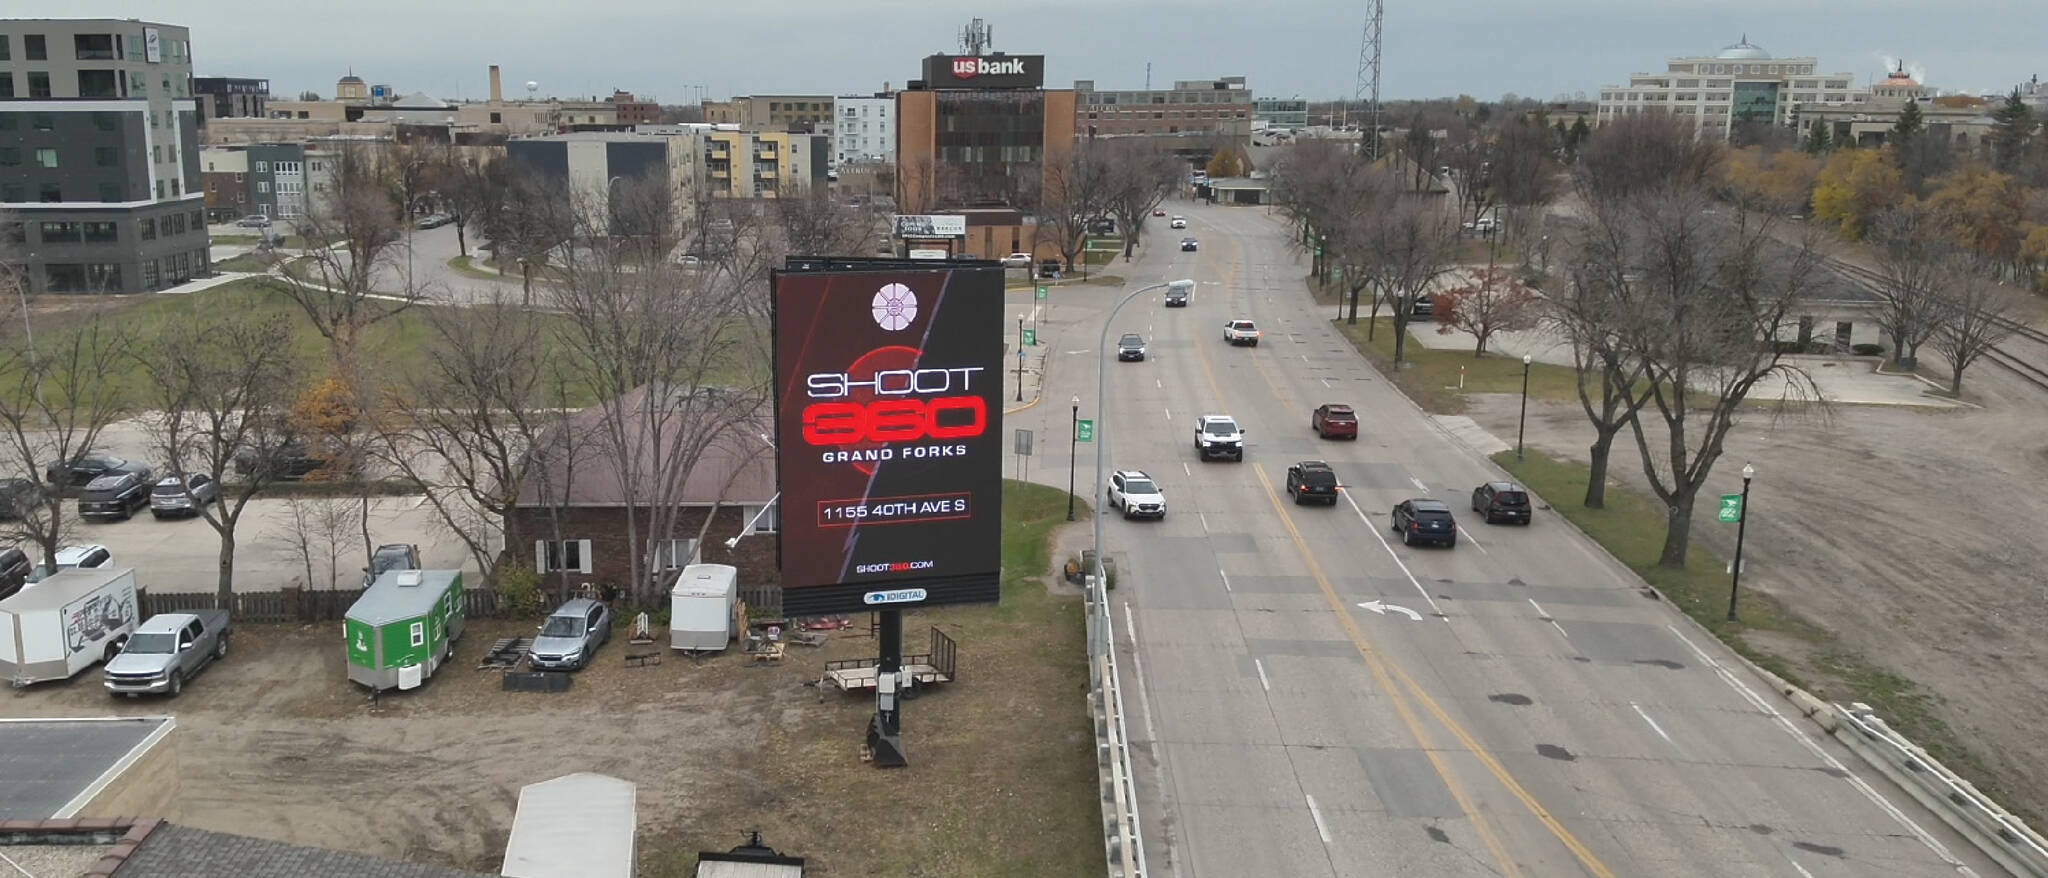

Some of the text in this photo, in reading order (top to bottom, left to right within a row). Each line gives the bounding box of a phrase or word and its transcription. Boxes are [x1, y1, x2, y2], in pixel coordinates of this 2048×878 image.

[807, 367, 984, 397] SHOOT
[802, 395, 987, 446] 360
[822, 445, 967, 463] GRAND FORKS
[823, 499, 966, 519] 1155 40TH AVE S
